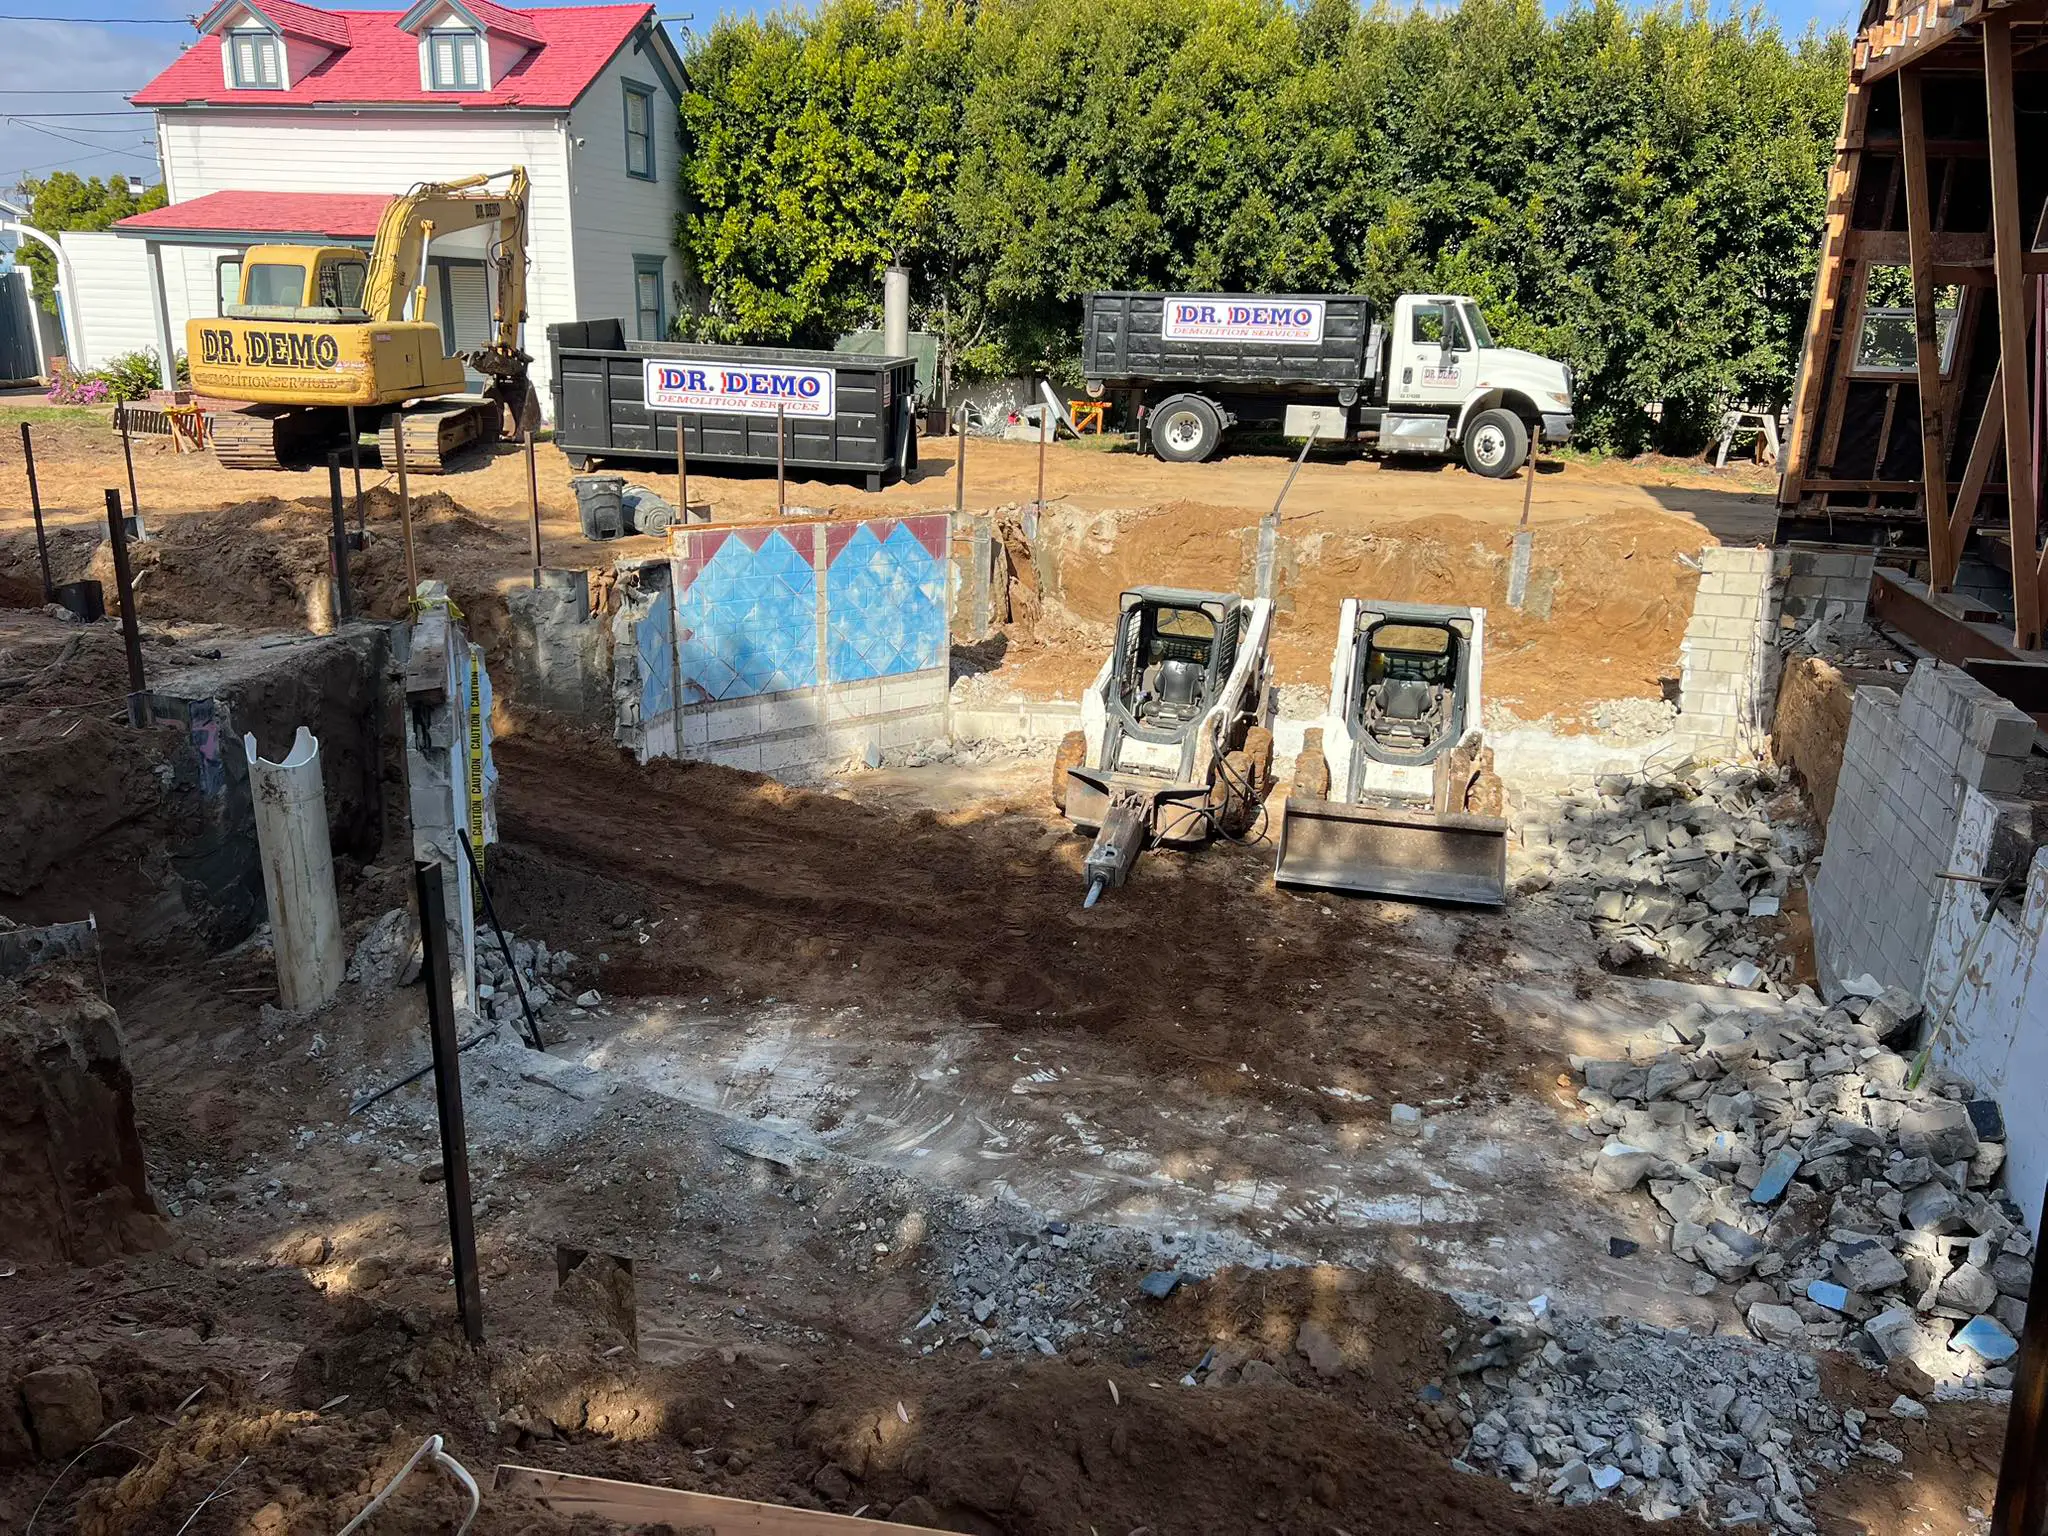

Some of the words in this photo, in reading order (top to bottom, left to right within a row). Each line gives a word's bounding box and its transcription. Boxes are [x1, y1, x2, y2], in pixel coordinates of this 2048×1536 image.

[1173, 327, 1249, 336] DEMOLITION
[1252, 329, 1310, 338] SERVICES
[1175, 304, 1222, 324] DR.
[1227, 306, 1312, 327] DEMO
[201, 329, 242, 365] DR.
[244, 330, 339, 370] DEMO
[657, 394, 747, 408] DEMOLITION
[658, 368, 714, 392] DR.
[721, 372, 820, 399] DEMO
[471, 671, 480, 707] CAUTION
[471, 713, 480, 750] CAUTION
[472, 759, 481, 794] CAUTION
[473, 800, 482, 836] CAUTION
